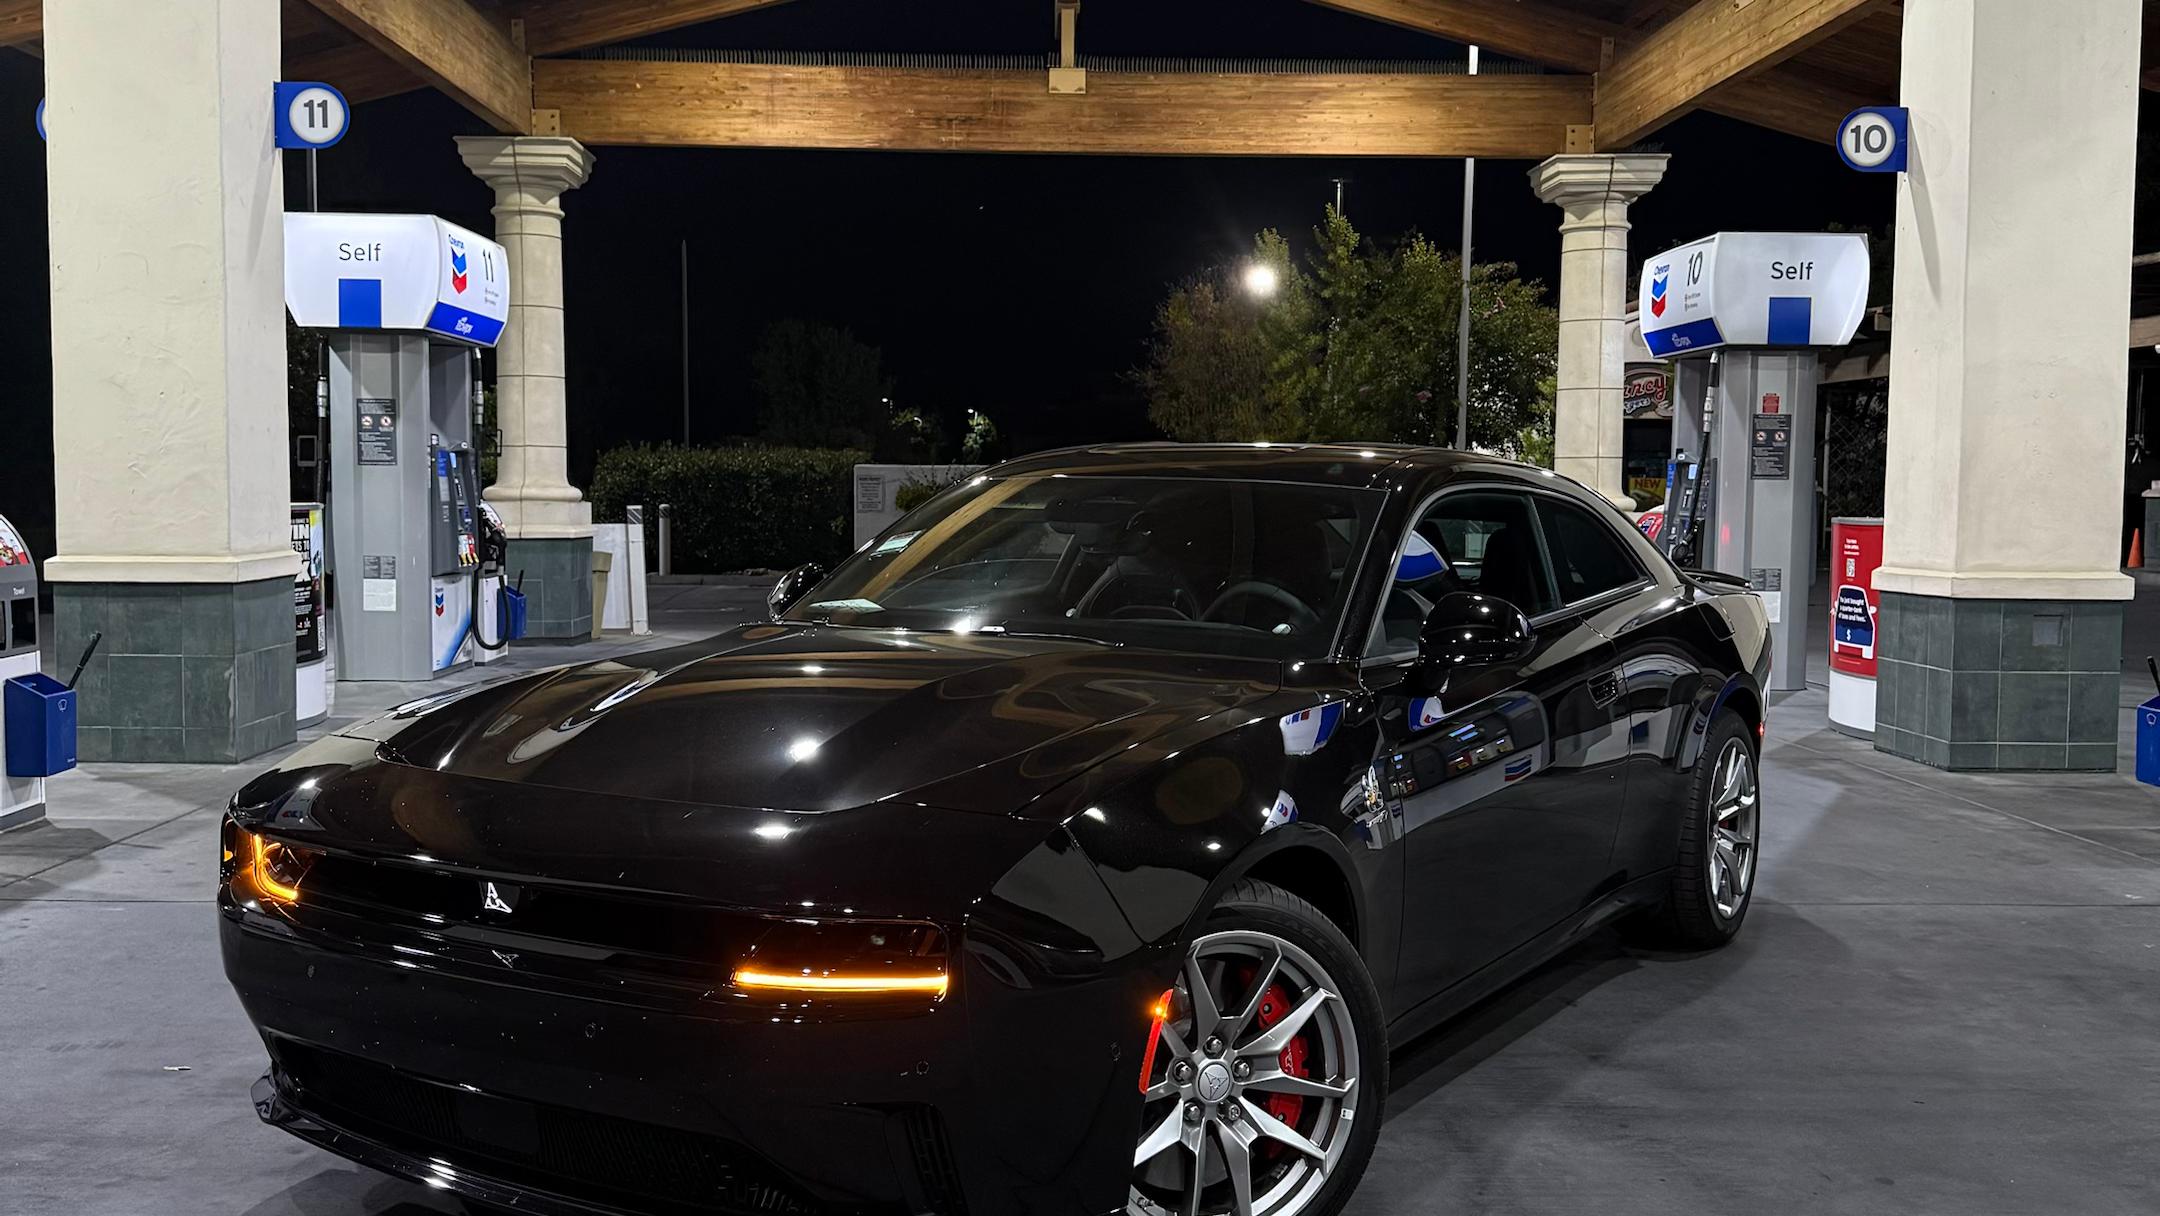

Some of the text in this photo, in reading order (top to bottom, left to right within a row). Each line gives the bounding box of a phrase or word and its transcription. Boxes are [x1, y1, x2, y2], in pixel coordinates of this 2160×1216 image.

[303, 99, 329, 129] 11
[1850, 125, 1887, 153] 10
[338, 242, 382, 263] Self
[482, 248, 494, 283] 11
[1687, 251, 1703, 287] 10
[1770, 261, 1813, 280] Self
[1634, 478, 1661, 489] NEW
